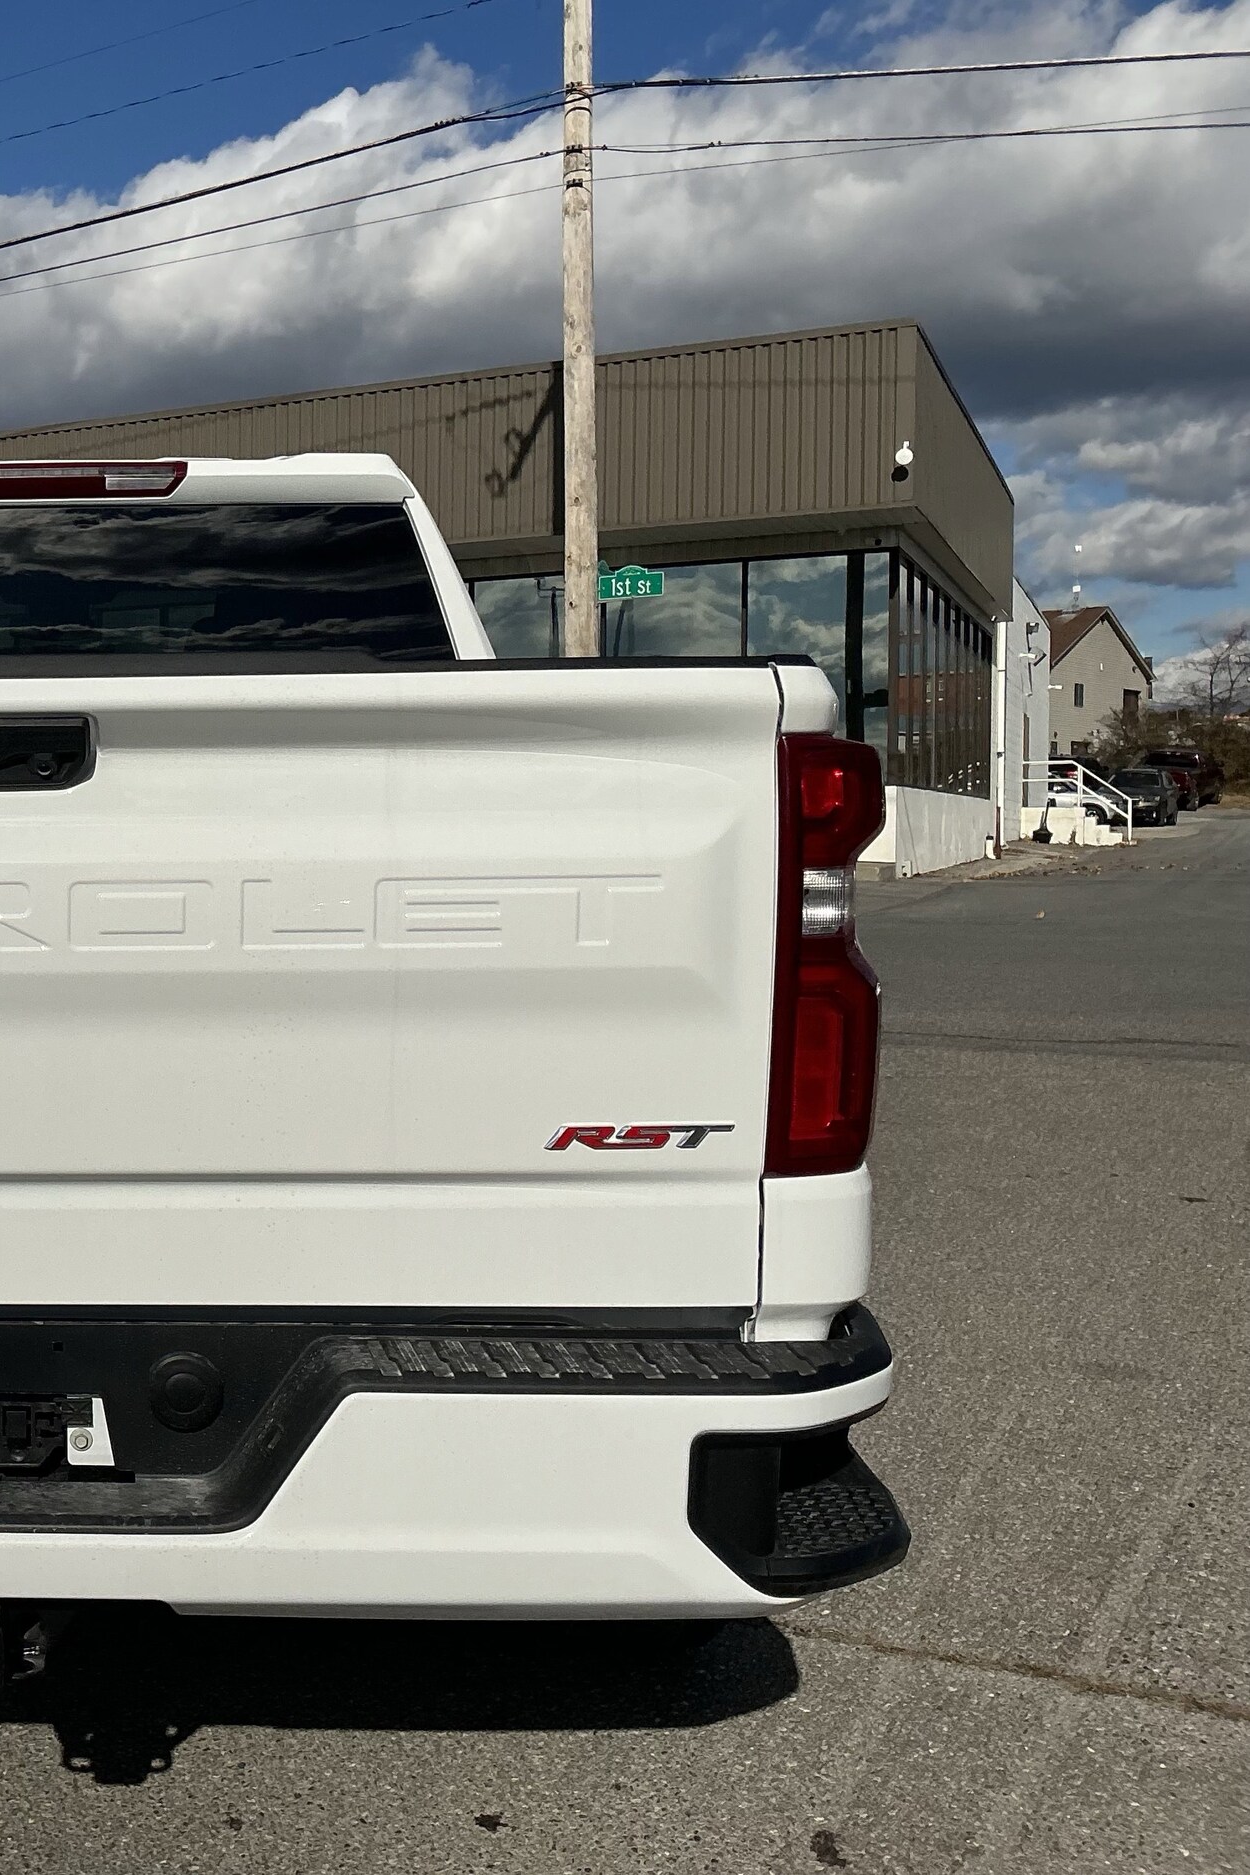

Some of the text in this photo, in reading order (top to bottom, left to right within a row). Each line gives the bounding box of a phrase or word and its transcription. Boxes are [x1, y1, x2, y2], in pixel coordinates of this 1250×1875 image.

[611, 578, 651, 596] 1st St
[543, 1122, 736, 1151] RST
